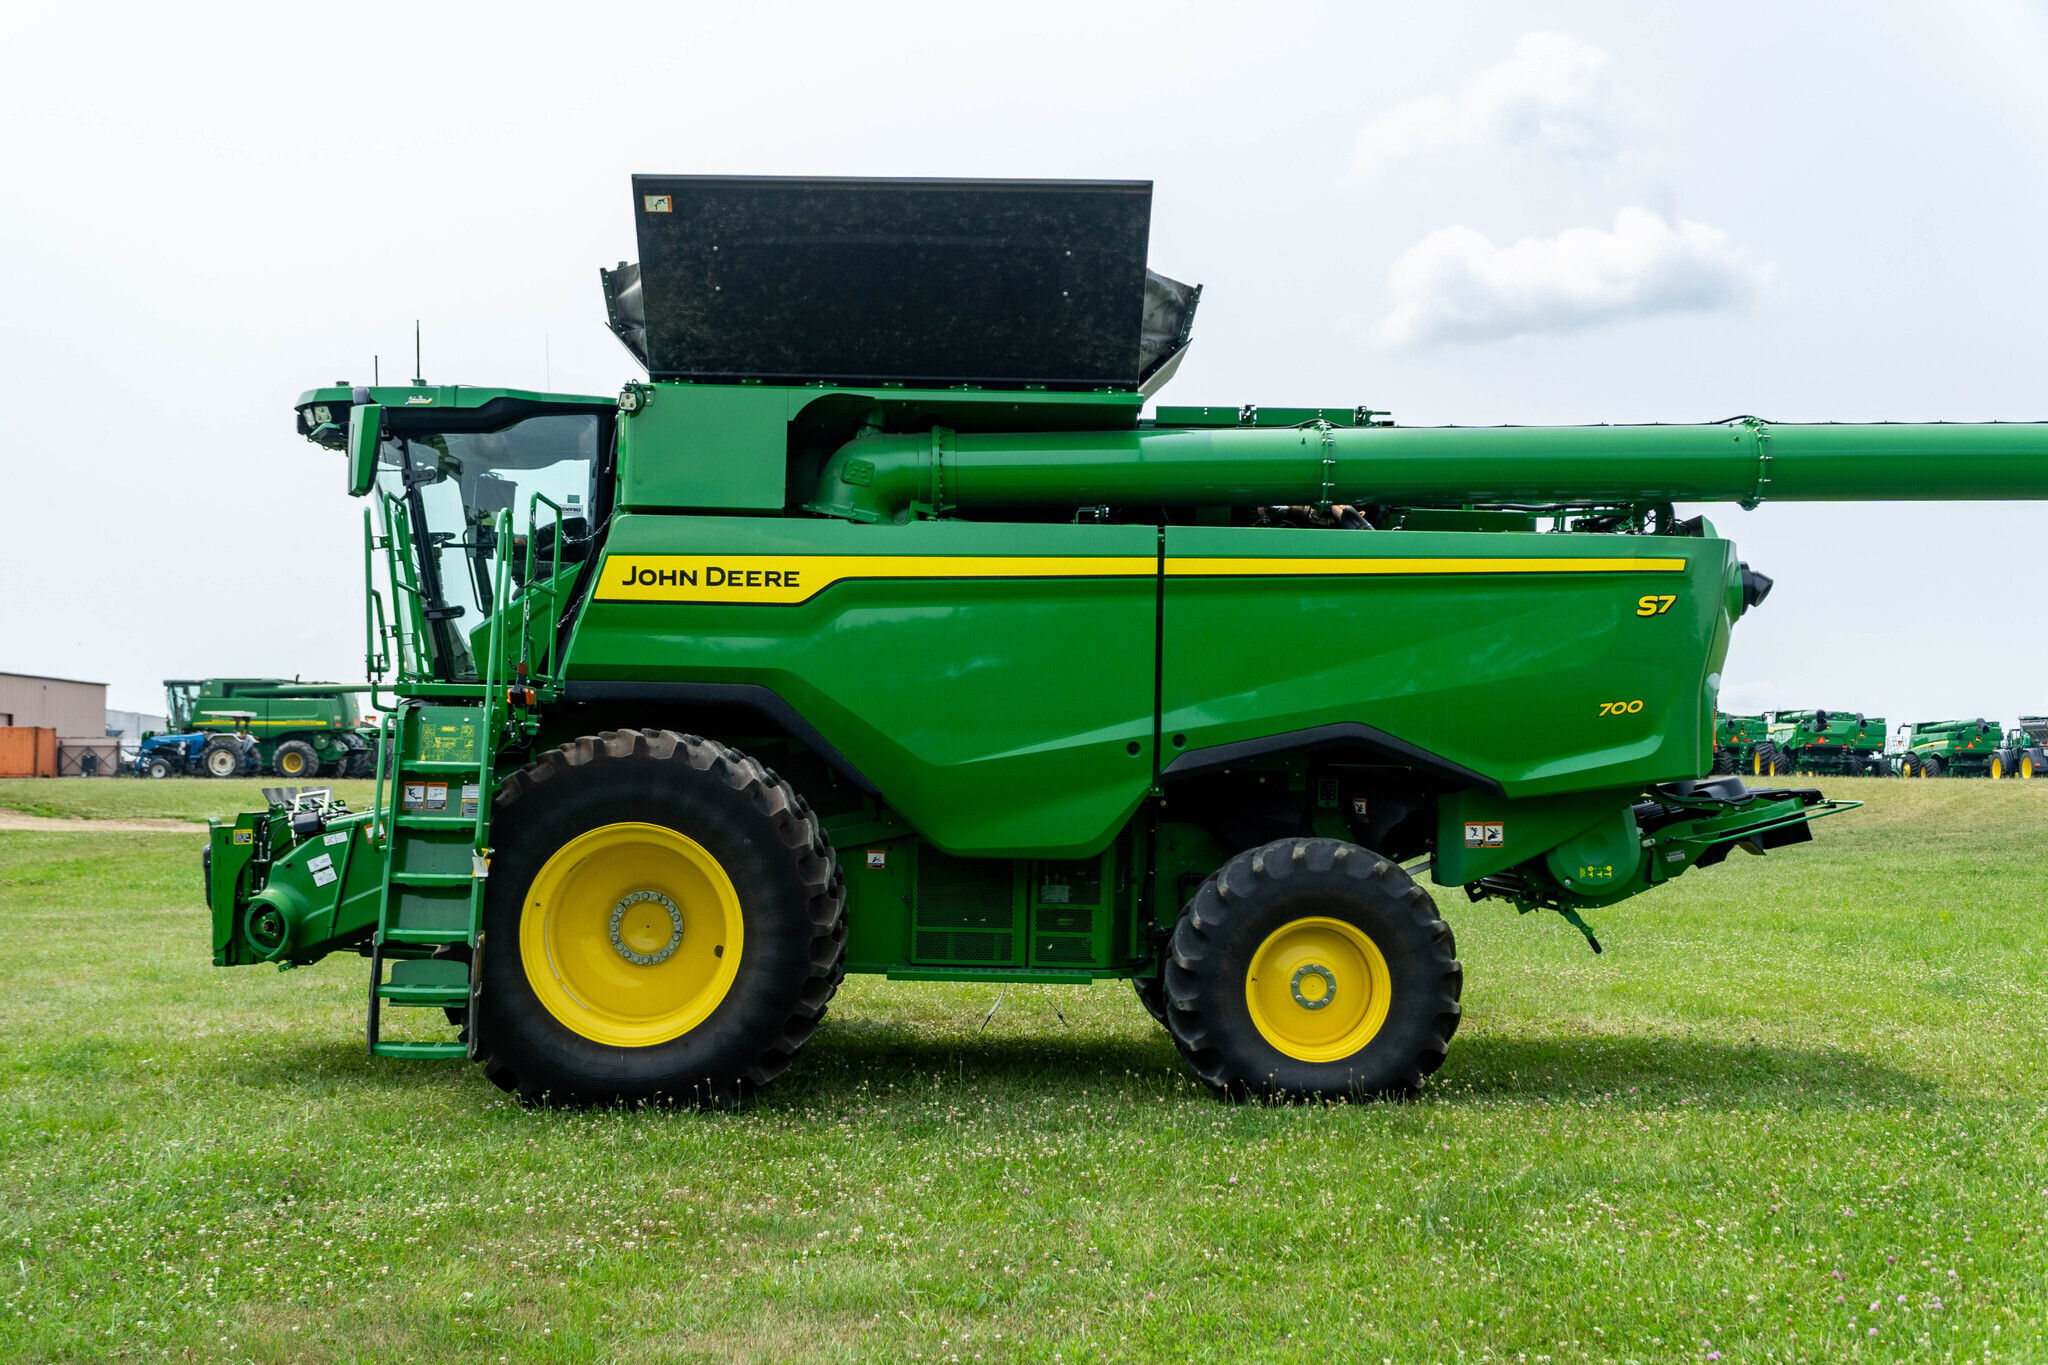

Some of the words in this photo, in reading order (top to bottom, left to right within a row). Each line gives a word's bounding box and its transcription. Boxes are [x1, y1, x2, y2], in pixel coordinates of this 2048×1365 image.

[622, 566, 698, 586] JOHN
[706, 566, 800, 587] DEERE
[1636, 595, 1677, 617] S7
[1599, 699, 1644, 717] 700
